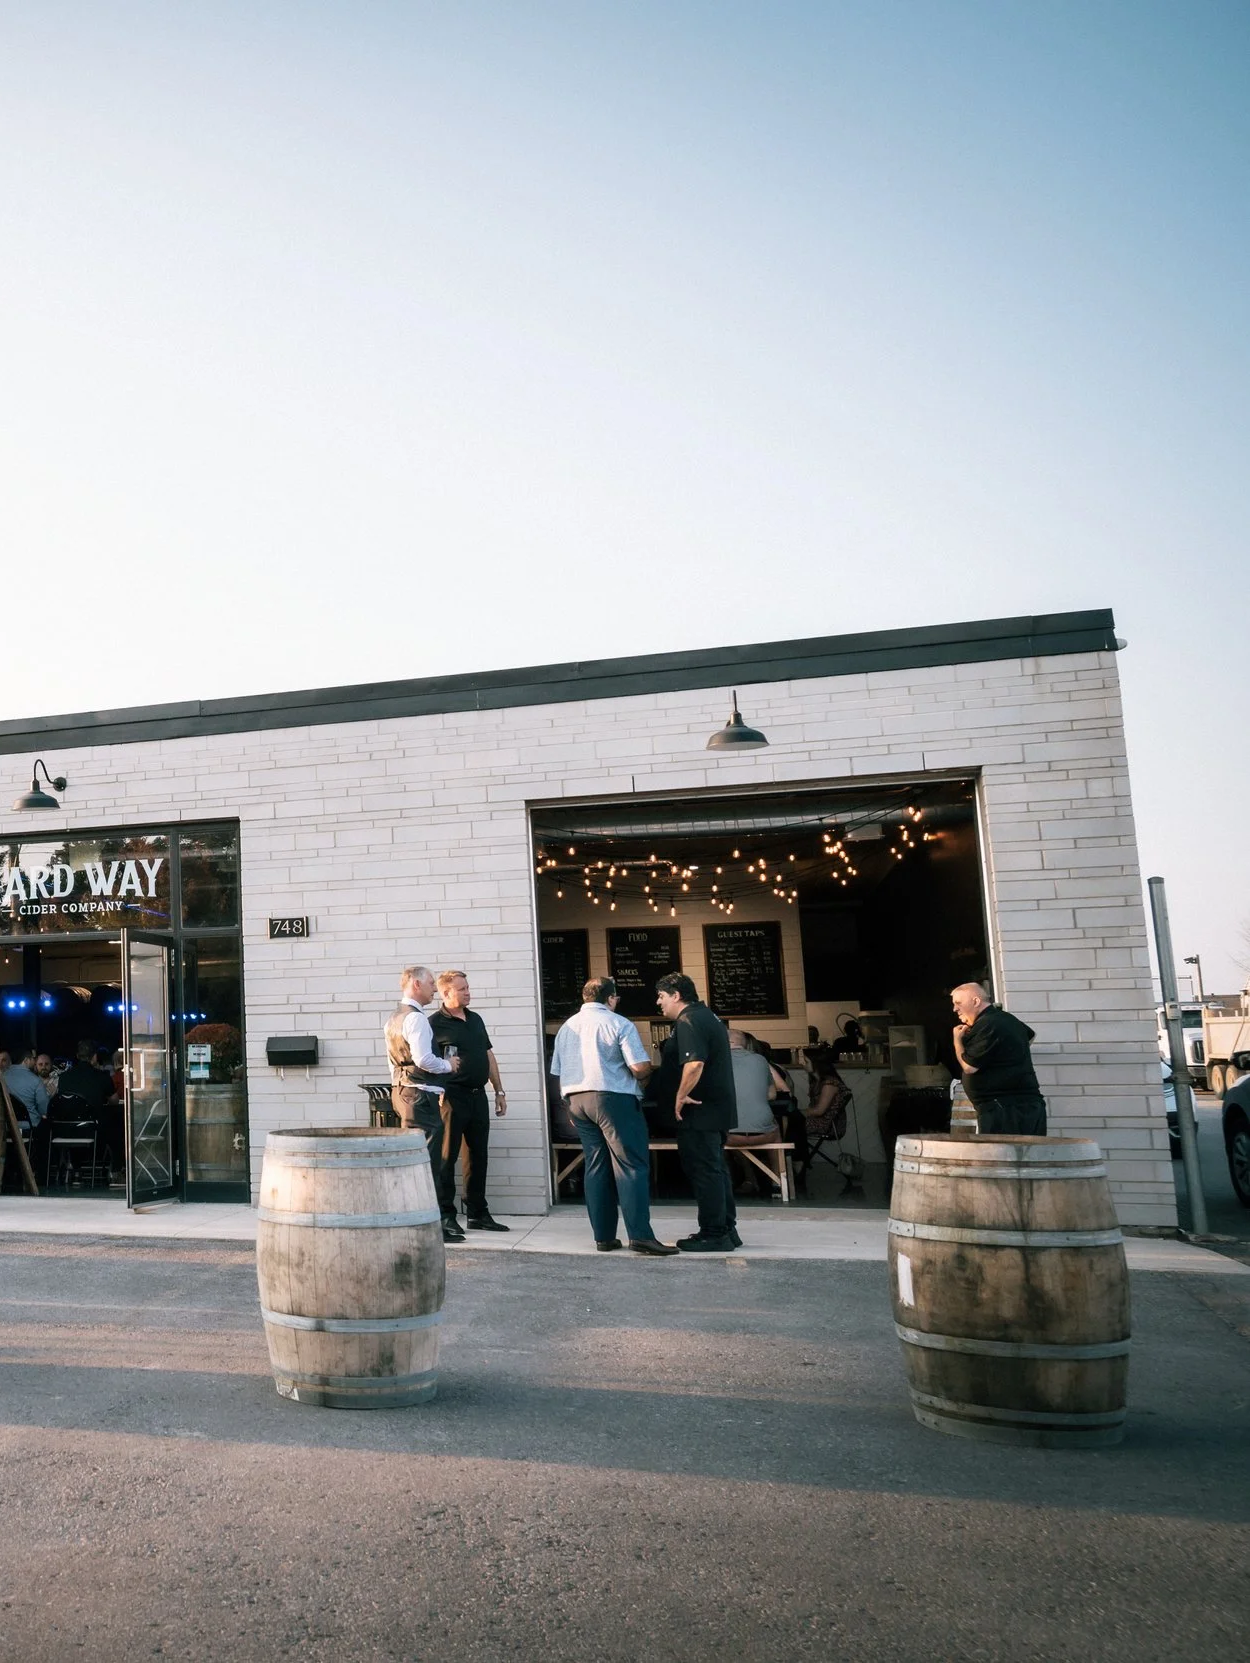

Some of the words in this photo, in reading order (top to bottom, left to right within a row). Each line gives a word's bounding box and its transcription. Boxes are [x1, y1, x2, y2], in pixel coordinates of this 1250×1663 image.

[83, 858, 165, 898] WAY
[20, 904, 57, 915] CIDER
[61, 901, 124, 914] COMPANY
[272, 919, 303, 935] 748
[628, 932, 649, 943] FOOD
[717, 930, 743, 938] GUEST
[744, 929, 766, 937] TAPS
[617, 968, 639, 976] SNACKS
